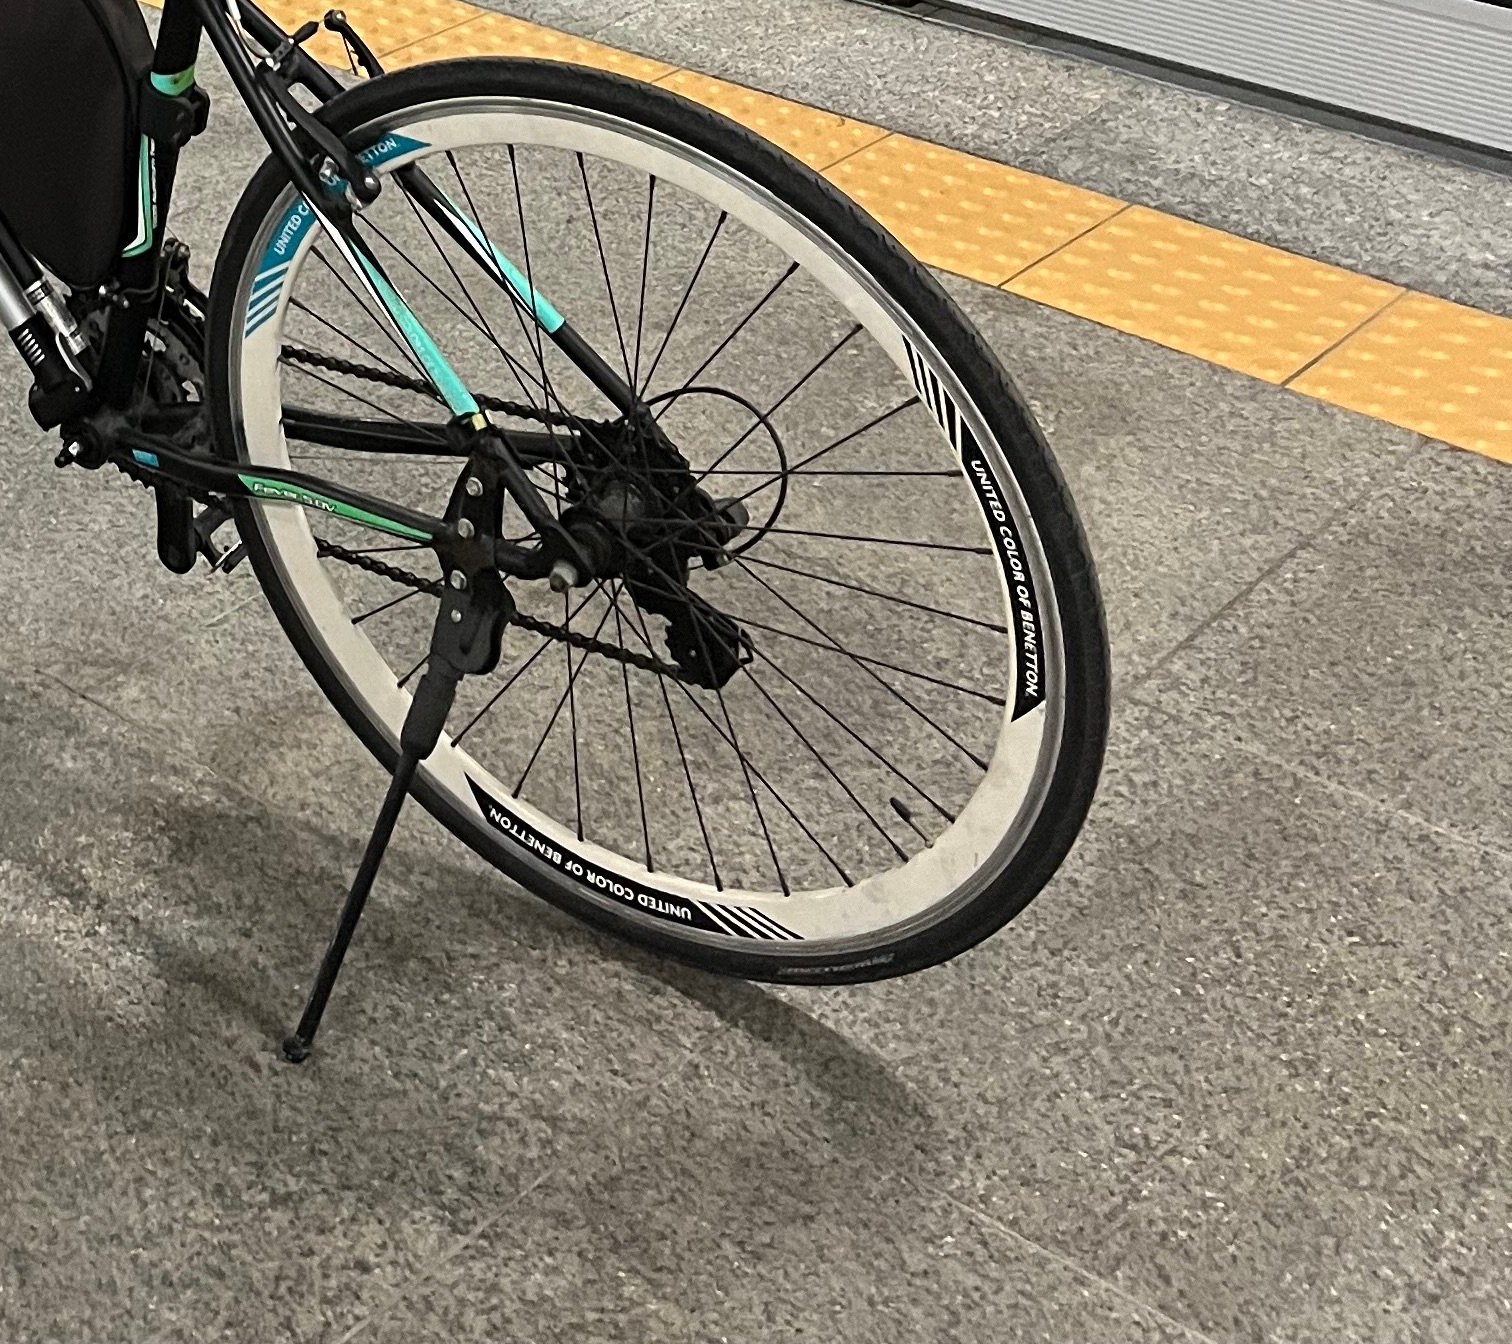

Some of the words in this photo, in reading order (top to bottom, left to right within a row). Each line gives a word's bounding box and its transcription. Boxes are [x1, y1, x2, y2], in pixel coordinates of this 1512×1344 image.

[273, 214, 302, 256] UNITED
[971, 460, 1006, 522] UNITED
[999, 525, 1026, 583] COLOR
[1016, 584, 1032, 609] OF
[564, 859, 584, 876] OF
[586, 868, 635, 901] COLOR
[637, 892, 692, 921] UNITED
